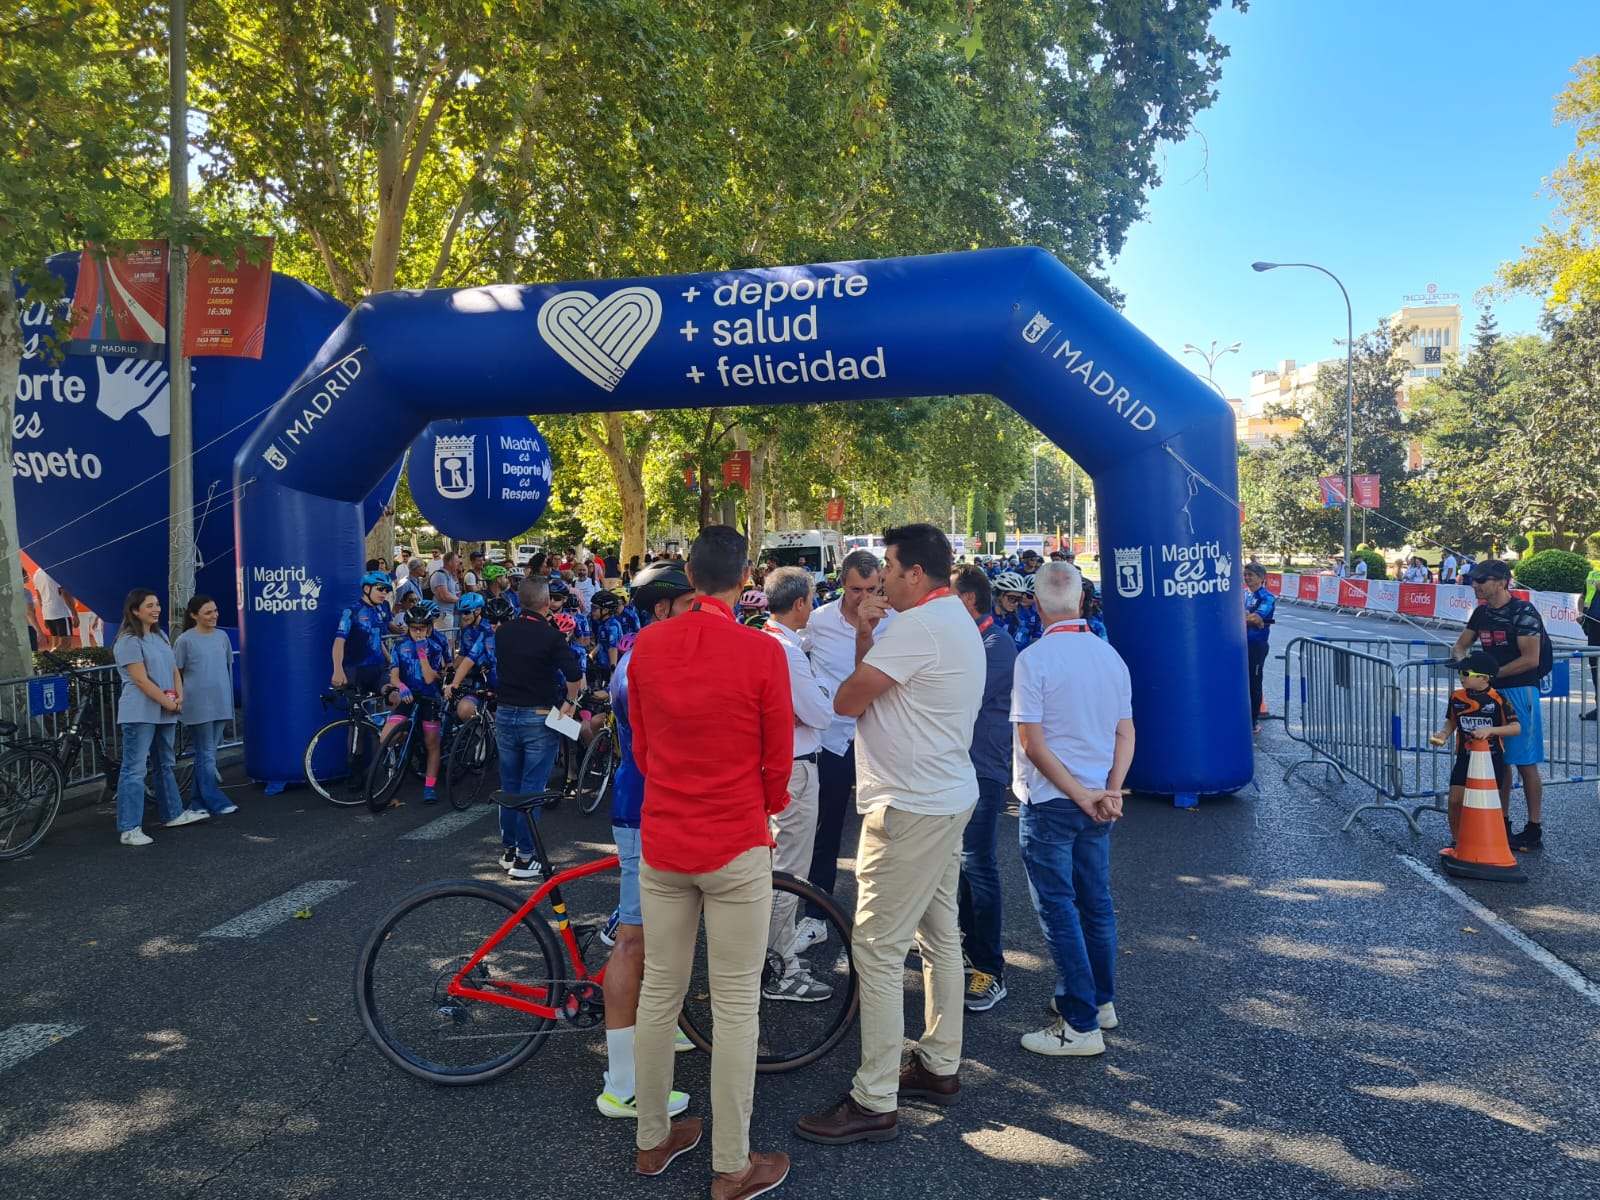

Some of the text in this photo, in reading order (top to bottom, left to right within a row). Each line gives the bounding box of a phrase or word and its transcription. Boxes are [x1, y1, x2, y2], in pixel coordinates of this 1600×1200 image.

[713, 273, 869, 310] deporte
[712, 305, 818, 347] salud
[101, 345, 138, 354] MADRID
[717, 347, 887, 388] felicidad
[1053, 339, 1158, 431] MADRID
[286, 355, 362, 446] MADRID
[12, 411, 45, 440] es
[500, 435, 541, 453] Madrid
[518, 452, 530, 462] es
[502, 462, 541, 477] Deporte
[519, 478, 530, 487] es
[501, 487, 540, 501] Respeto
[1161, 540, 1220, 562] Madrid
[254, 566, 306, 581] Madrid
[1174, 559, 1207, 582] es
[262, 581, 291, 599] es
[1163, 575, 1230, 599] Deporte
[255, 596, 318, 614] Deporte
[1551, 605, 1577, 622] Cofid
